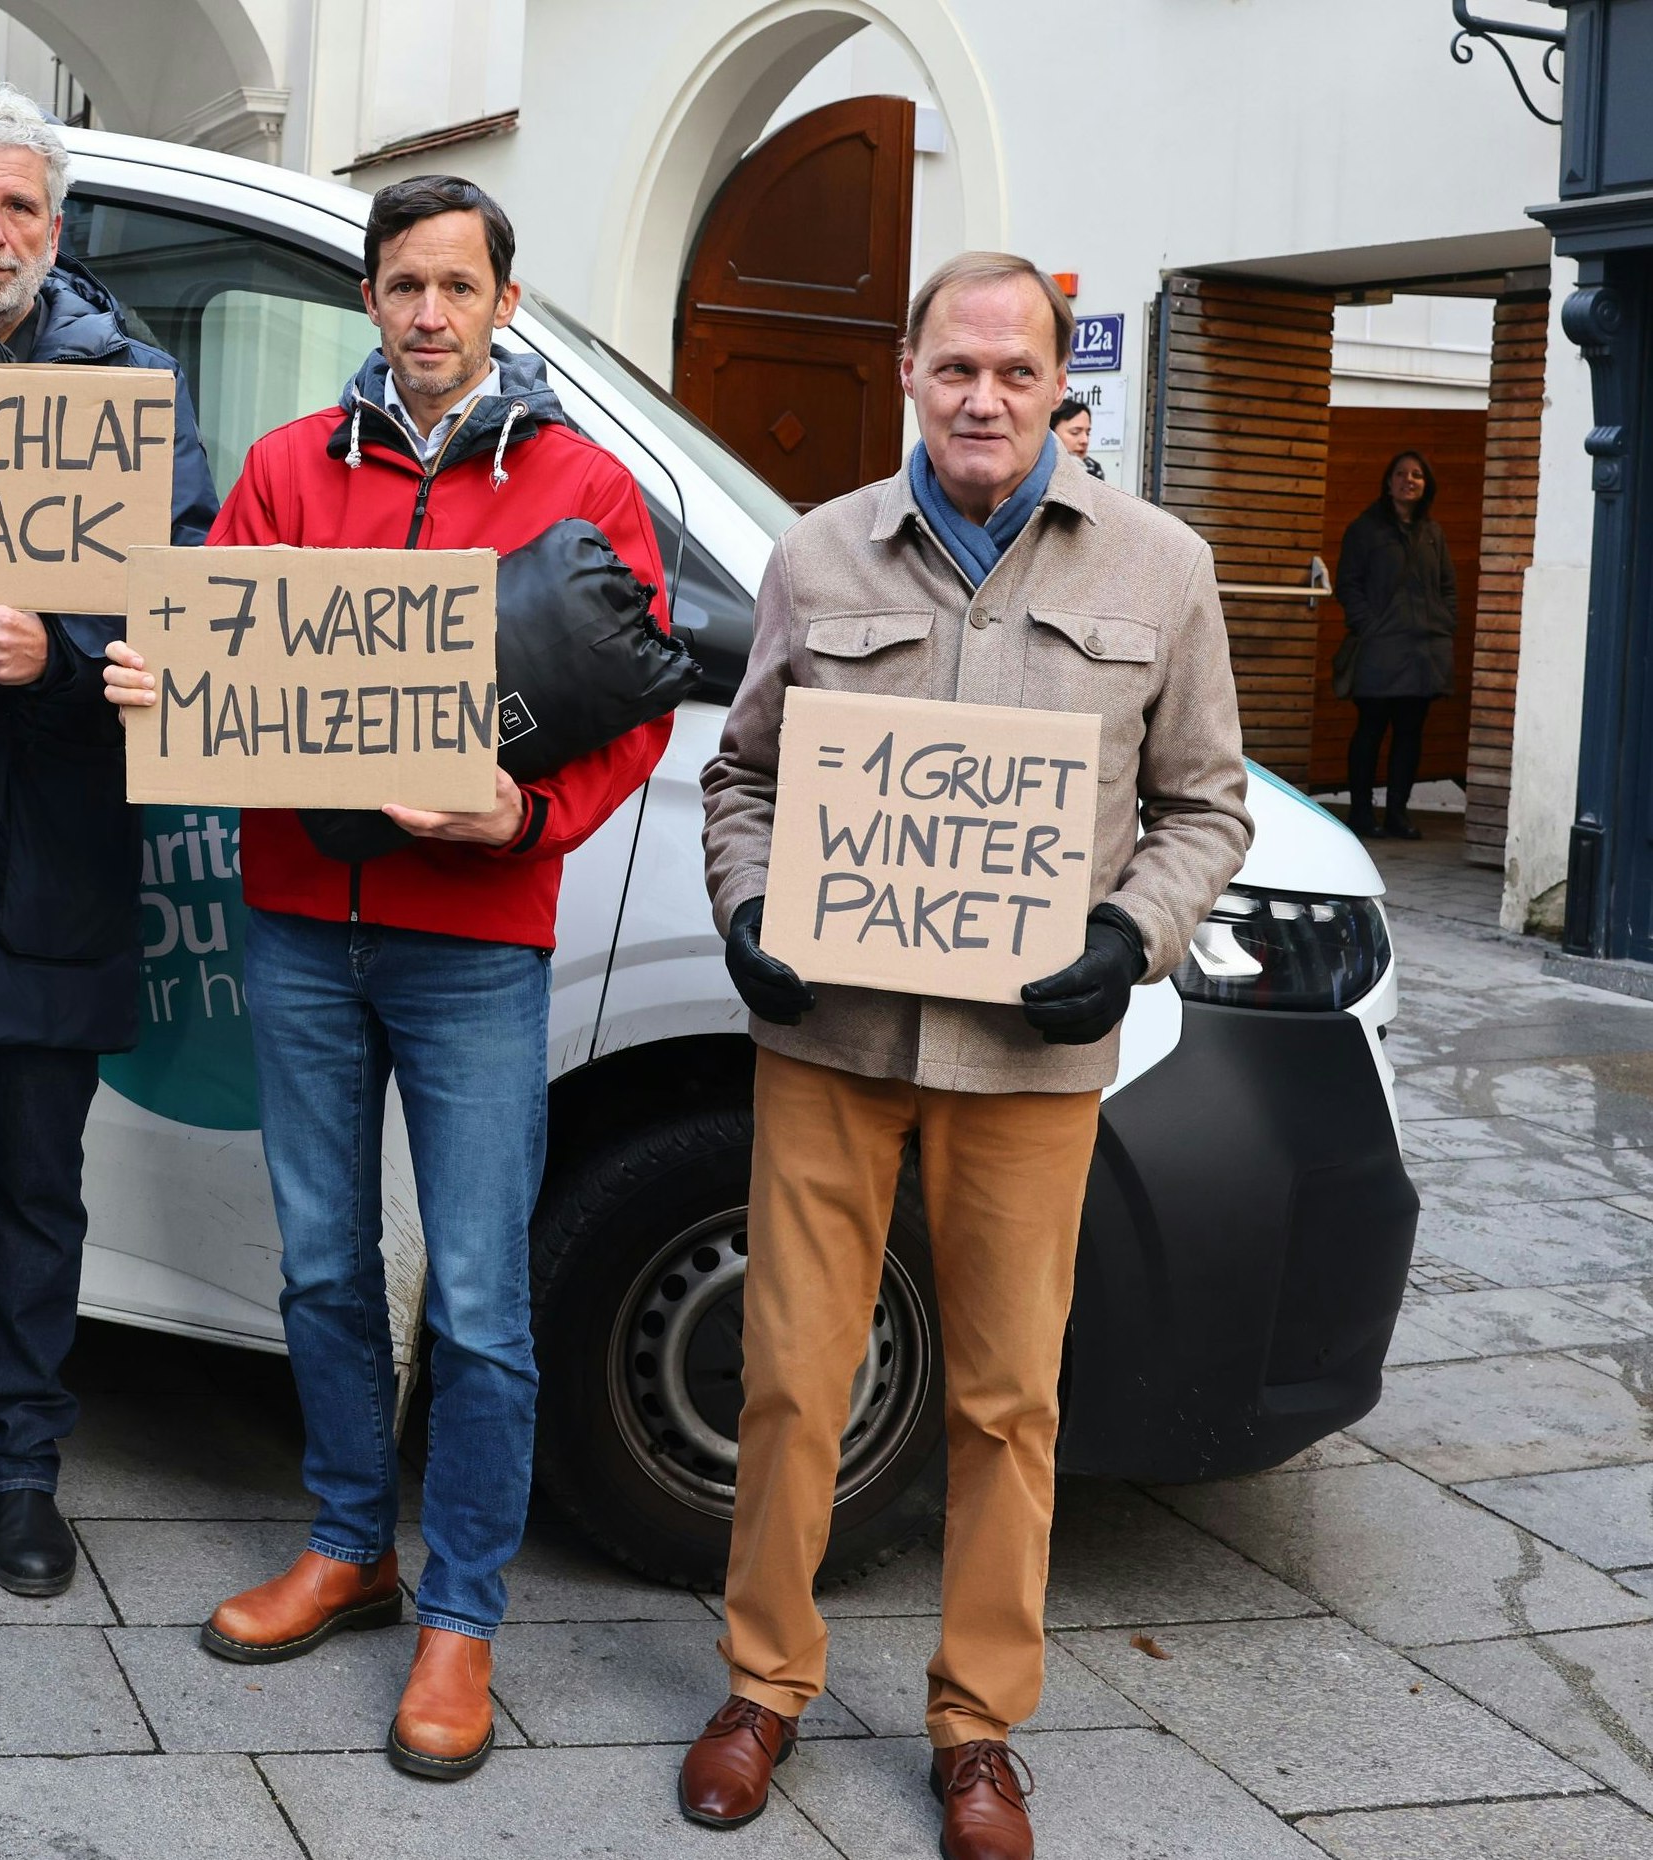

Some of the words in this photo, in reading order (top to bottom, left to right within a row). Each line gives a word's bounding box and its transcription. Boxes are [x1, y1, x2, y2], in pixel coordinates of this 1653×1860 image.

[1075, 321, 1113, 352] 12a
[208, 576, 257, 656] 7
[278, 577, 479, 656] WARME
[160, 668, 496, 757] MAHLZEITEN
[862, 731, 893, 796] 1
[901, 742, 1087, 809] GRUFT
[819, 804, 1085, 878] WINTER-
[813, 872, 1051, 956] PAKET
